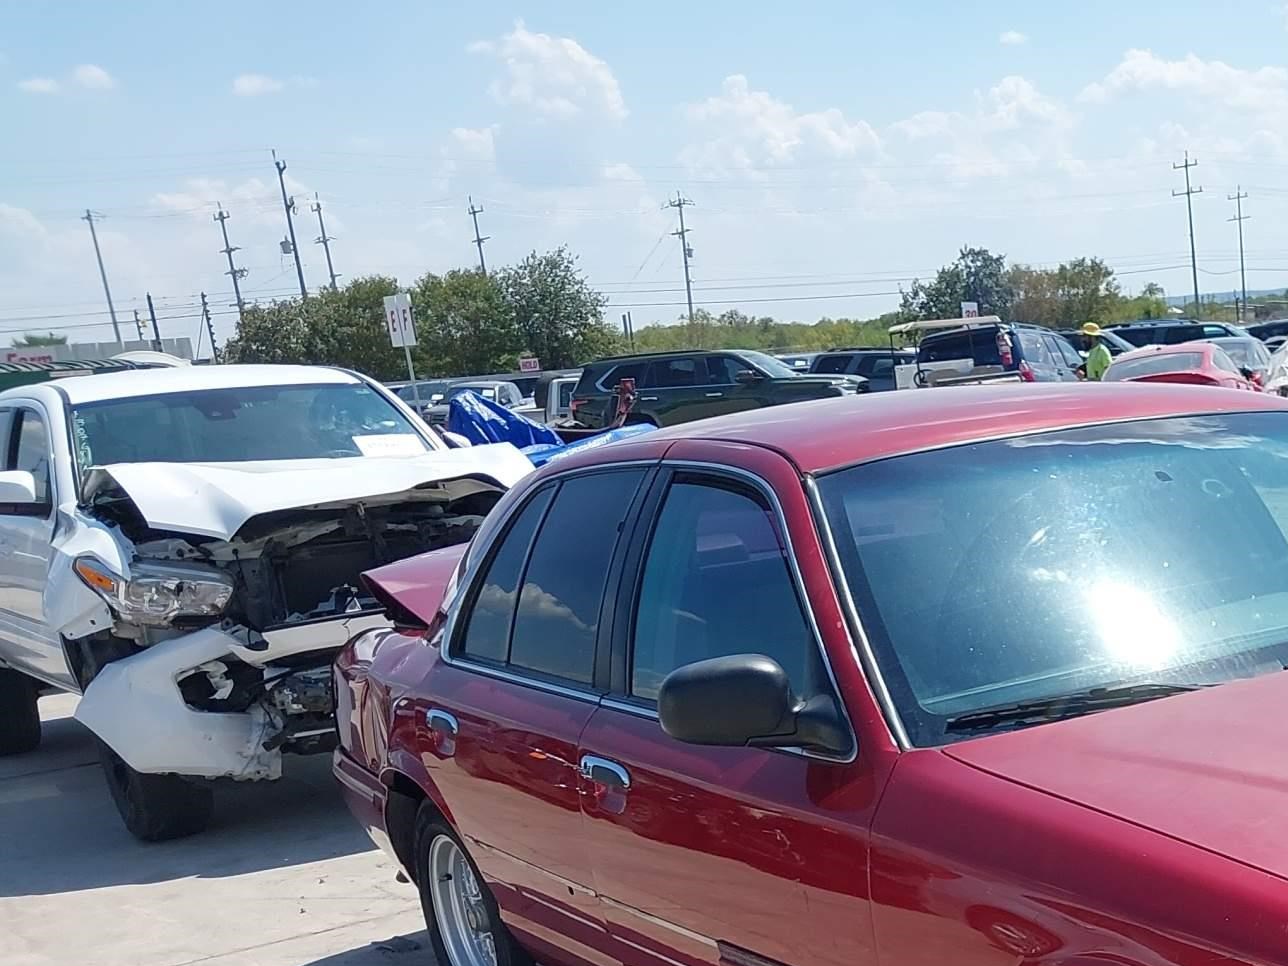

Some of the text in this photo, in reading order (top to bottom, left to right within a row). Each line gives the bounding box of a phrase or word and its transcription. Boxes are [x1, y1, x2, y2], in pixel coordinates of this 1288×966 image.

[390, 309, 408, 332] E F
[521, 359, 538, 370] HOLD
